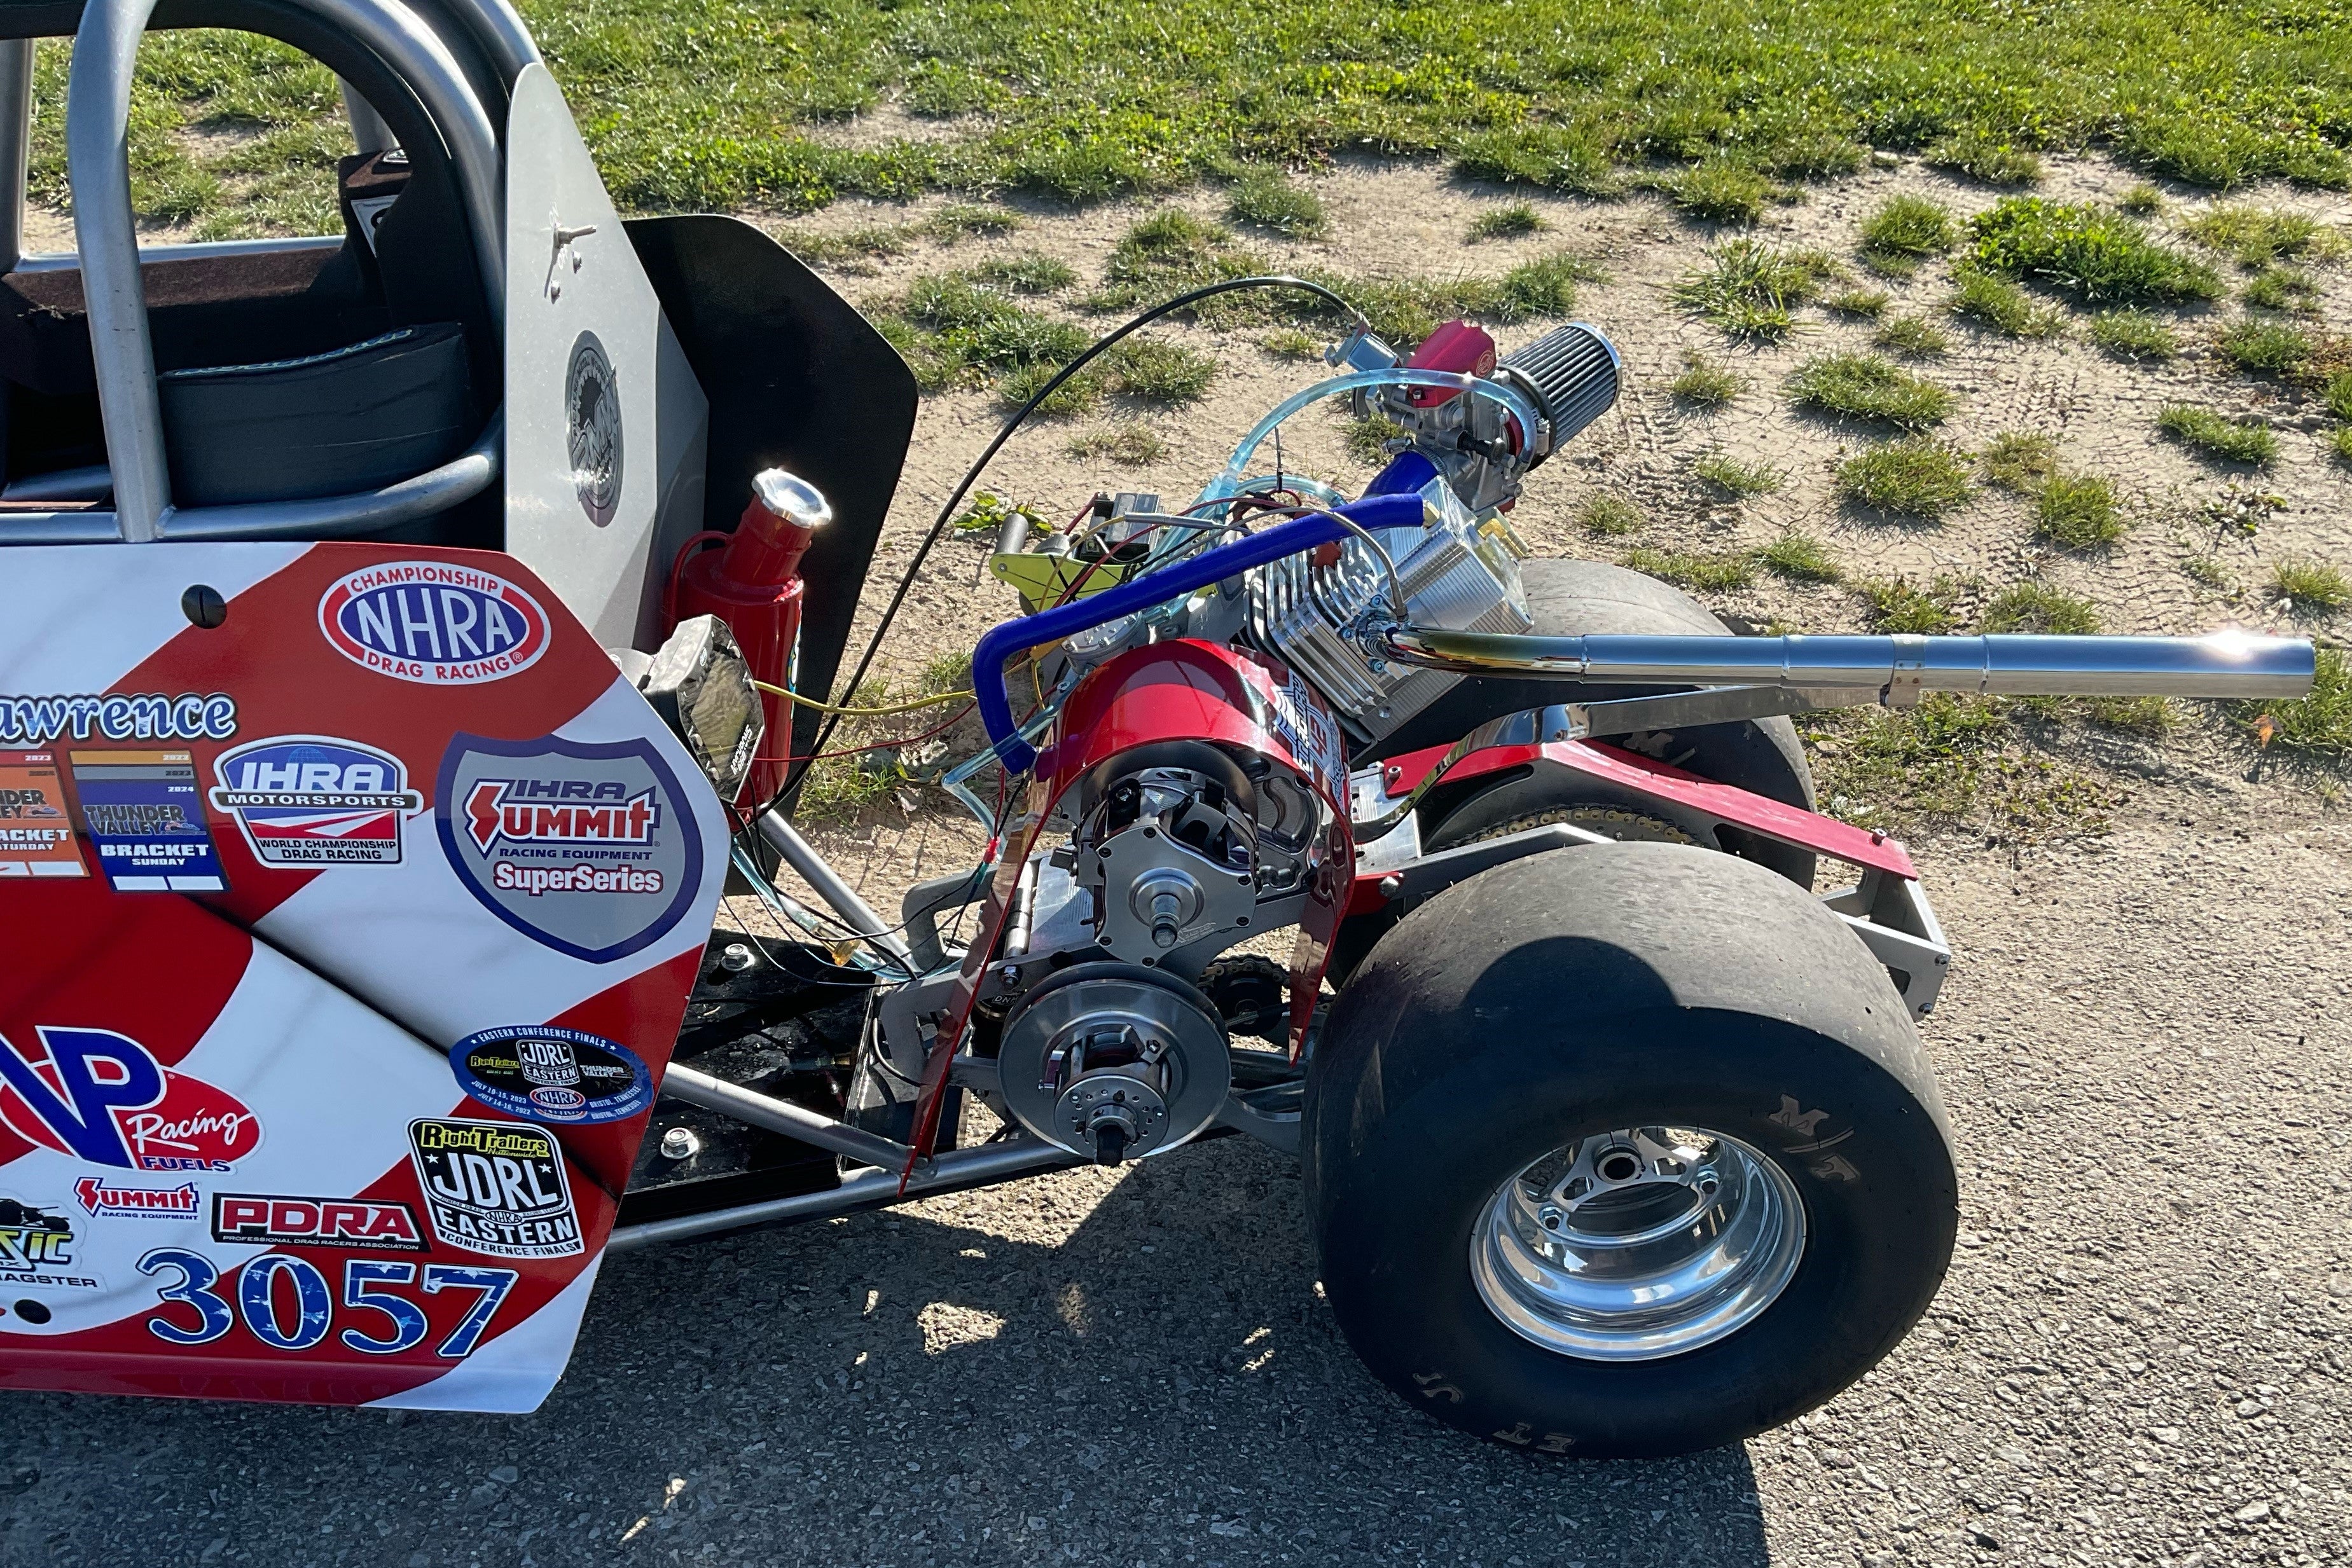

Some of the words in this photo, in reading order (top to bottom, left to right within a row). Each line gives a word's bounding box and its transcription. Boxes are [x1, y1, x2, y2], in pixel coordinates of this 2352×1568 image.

[350, 566, 499, 593] CHAMPIONSHIP
[356, 587, 512, 659] NHRA
[368, 651, 424, 678] DRAG
[436, 655, 509, 679] RACING
[236, 762, 384, 791] IHRA
[514, 779, 626, 799] IHRA
[227, 794, 406, 806] MOTORSPORTS
[83, 804, 186, 821] THUNDER
[91, 820, 162, 836] VALLEY
[100, 844, 209, 856] BRACKET
[259, 839, 301, 848] WORLD
[307, 840, 396, 849] CHAMPIONSHIP
[282, 849, 321, 859] DRAG
[326, 849, 382, 859] RACING
[499, 848, 557, 858] RACING
[562, 849, 653, 860] EQUIPMENT
[497, 863, 661, 895] SuperSeries
[478, 1028, 514, 1042] EASTERN
[516, 1027, 572, 1039] CONFERENCE
[575, 1031, 606, 1048] FINALS
[523, 1043, 571, 1067] JDRL
[525, 1064, 576, 1080] EASTERN
[471, 1080, 487, 1090] JULY
[510, 1094, 527, 1104] 2023
[478, 1092, 494, 1103] JULY
[539, 1091, 577, 1104] NHRA
[126, 1108, 250, 1153] Racing
[141, 1157, 231, 1173] FUELS
[433, 1152, 557, 1210] JDRL
[221, 1197, 420, 1242] PDRA
[436, 1205, 574, 1244] EASTERN
[488, 1211, 522, 1223] NHRA
[223, 1235, 292, 1244] PROFESSIONAL
[359, 1242, 419, 1250] ASSOCIATION
[446, 1232, 530, 1256] CONFERENCE
[534, 1242, 576, 1256] FINALS
[0, 1273, 98, 1288] AGSTER
[136, 1247, 519, 1359] 3057
